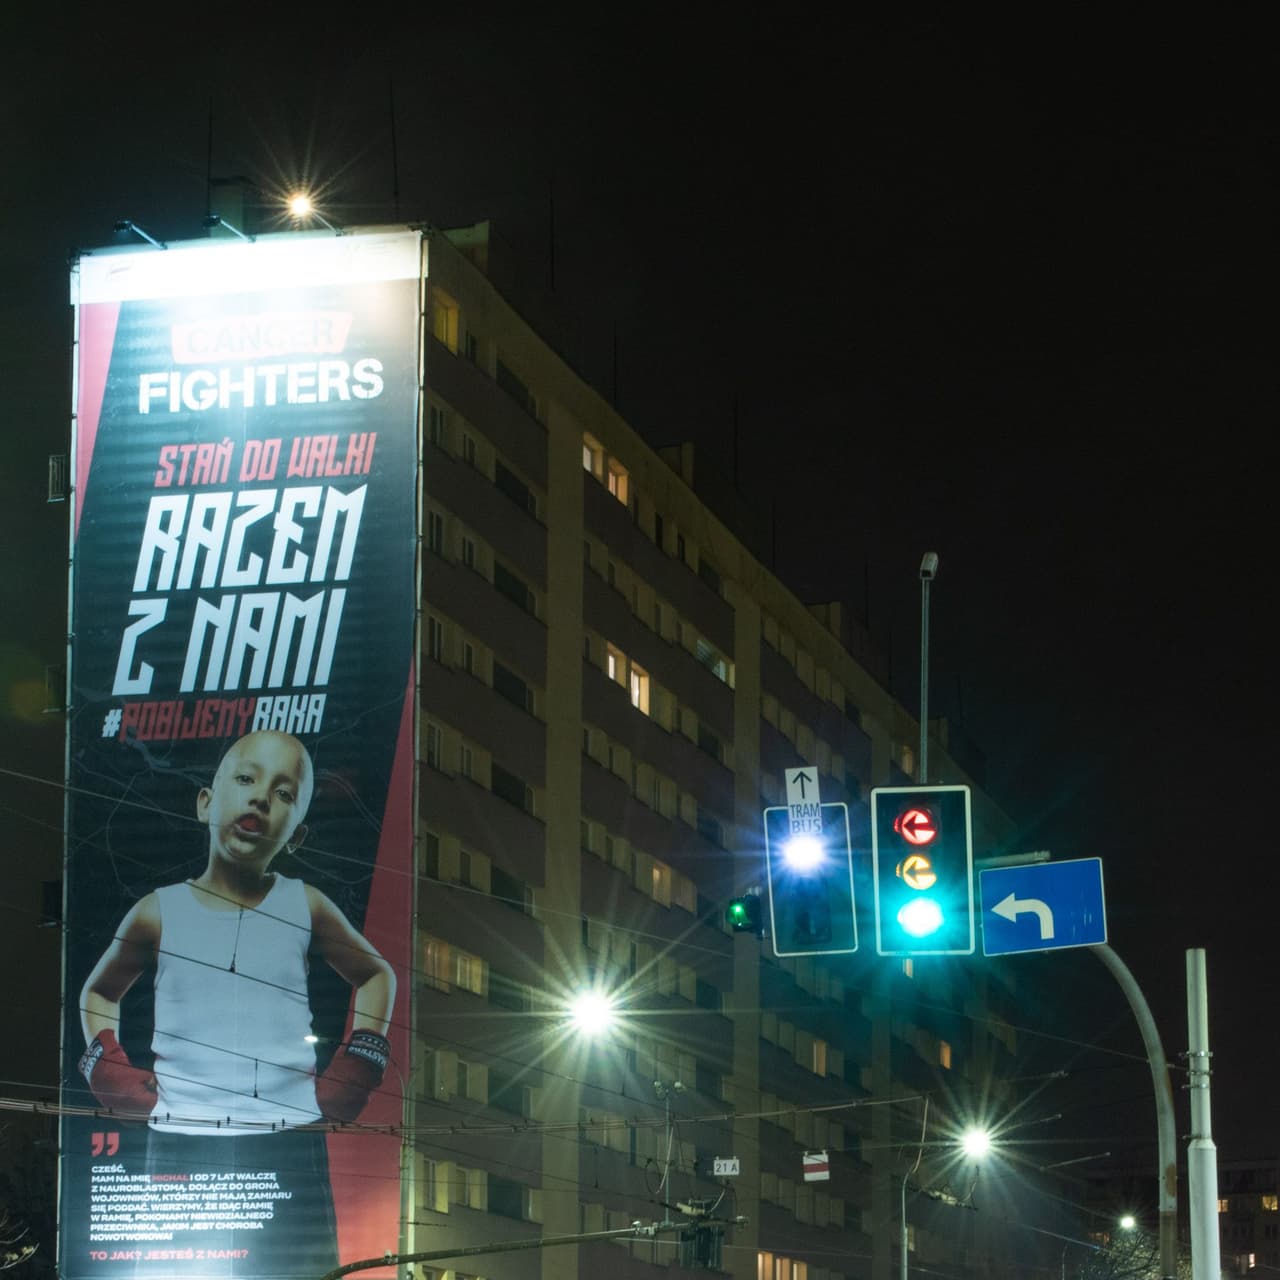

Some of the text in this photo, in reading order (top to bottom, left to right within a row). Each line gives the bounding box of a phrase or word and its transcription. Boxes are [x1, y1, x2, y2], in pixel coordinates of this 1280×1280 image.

[138, 357, 384, 415] FIGHTERS
[154, 432, 377, 488] STAŃ DO WALKI
[132, 483, 368, 593] RAZEM
[111, 587, 347, 697] Z NAMI
[790, 802, 820, 818] TRAM
[791, 818, 822, 834] BUS
[91, 1163, 126, 1174] CZEŚĆ,
[715, 1163, 738, 1173] 21 A
[91, 1175, 115, 1183] MAM
[115, 1175, 130, 1183] NA
[130, 1174, 151, 1184] IMIĘ
[194, 1173, 209, 1181] OD
[210, 1173, 217, 1181] 7
[217, 1172, 236, 1181] LAT
[236, 1172, 277, 1182] WALCZĘ
[91, 1185, 99, 1193] Z
[188, 1182, 228, 1193] DOŁĄCZ
[228, 1182, 243, 1191] DO
[244, 1181, 280, 1190] GRONA
[162, 1192, 201, 1202] KTÓRZY
[201, 1192, 219, 1201] NIE
[219, 1192, 247, 1202] MAJĄ
[247, 1191, 293, 1200] ZAMIARU
[90, 1203, 107, 1214] SIĘ
[218, 1201, 242, 1212] IDĄC
[242, 1201, 274, 1211] RAMIĘ
[90, 1214, 101, 1222] W
[134, 1213, 191, 1222] POKONAMY
[190, 1211, 274, 1221] NIEWIDZIALNEGO
[190, 1221, 215, 1231] JEST
[215, 1221, 264, 1230] CHOROBA
[90, 1247, 249, 1261] TO JAK? JESTEŚ Z NAMI?
